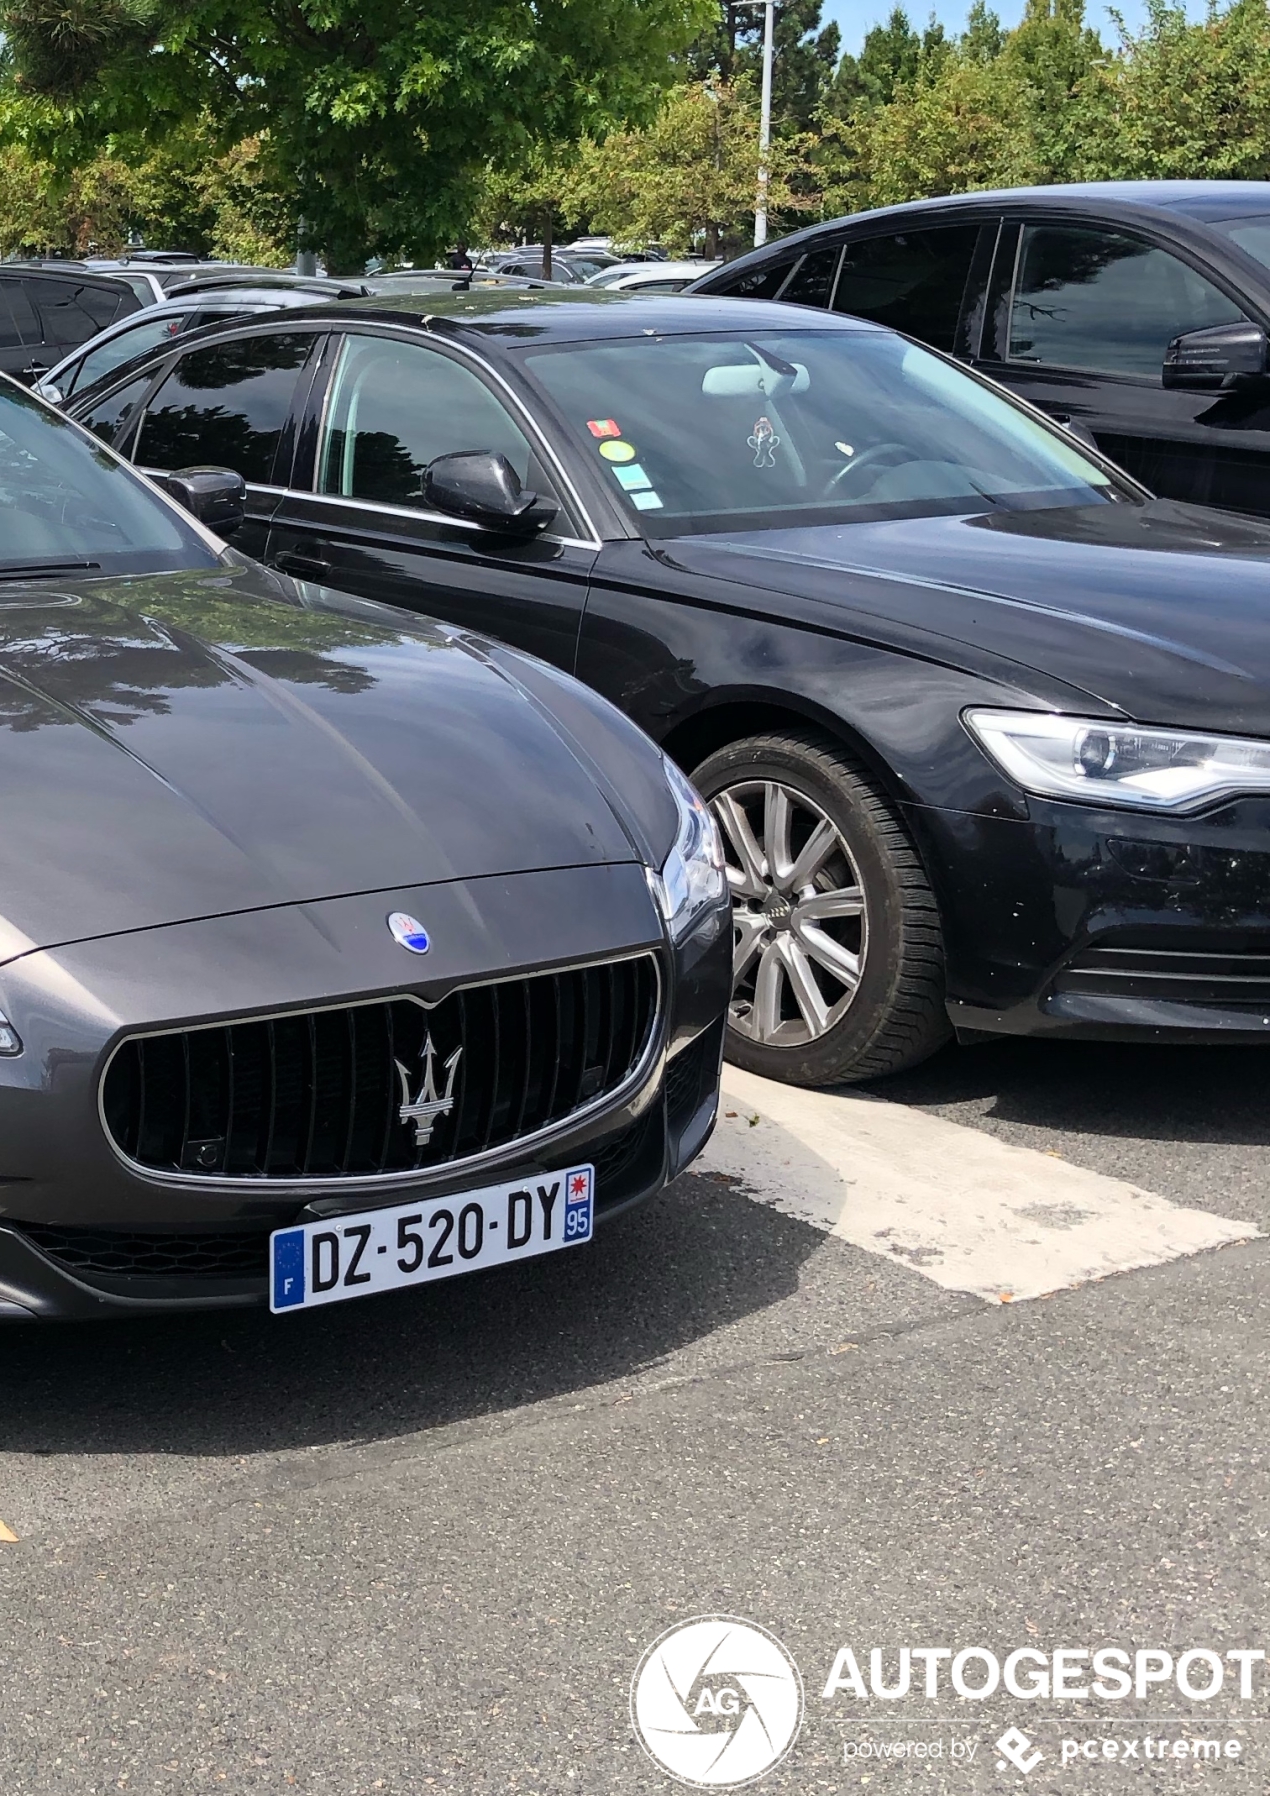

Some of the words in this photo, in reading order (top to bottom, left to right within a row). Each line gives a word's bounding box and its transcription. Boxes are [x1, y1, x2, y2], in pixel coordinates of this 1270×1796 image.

[567, 1206, 588, 1236] 95
[311, 1181, 561, 1294] DZ-520-DY
[283, 1277, 294, 1296] F
